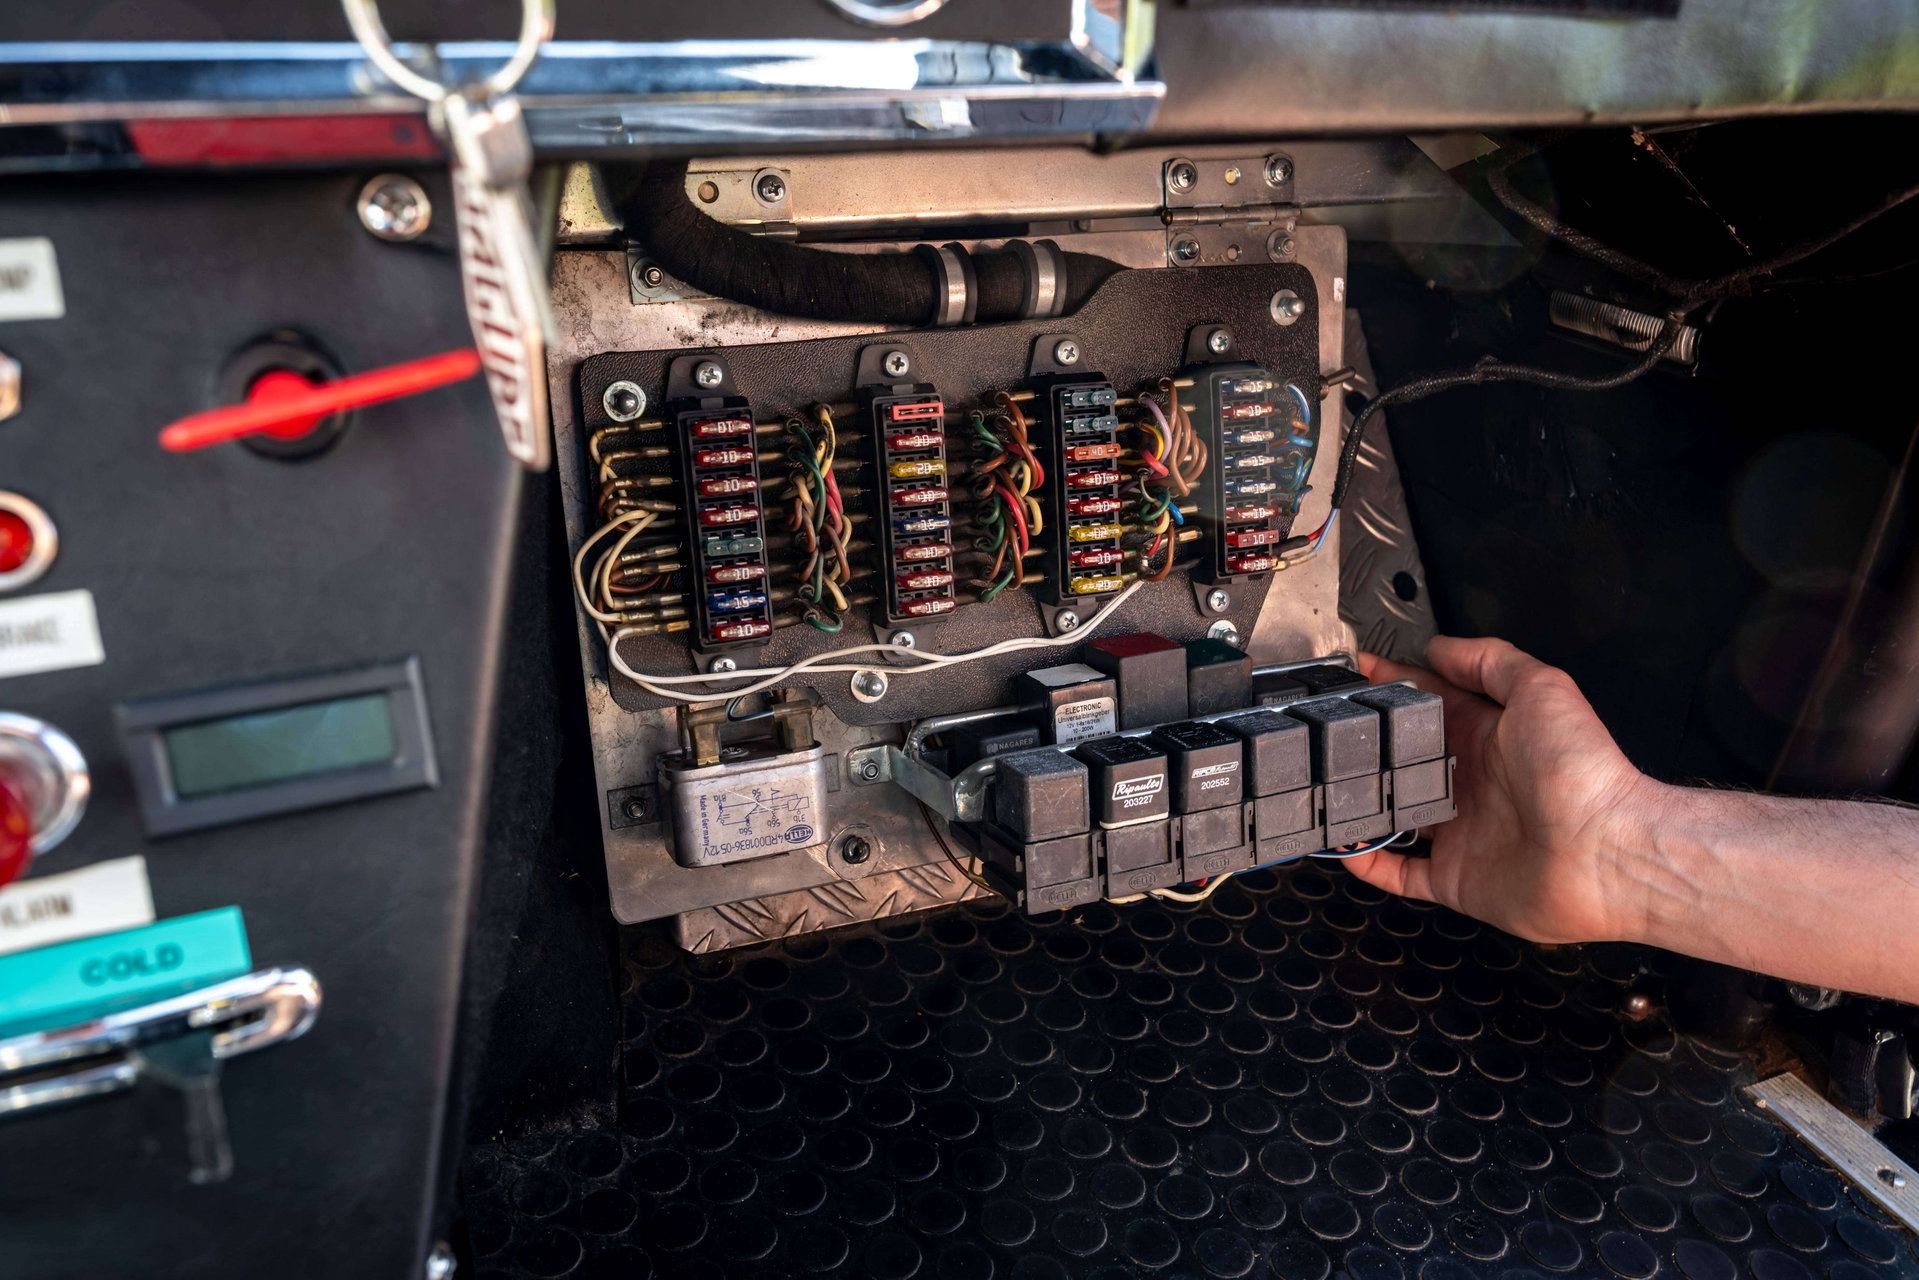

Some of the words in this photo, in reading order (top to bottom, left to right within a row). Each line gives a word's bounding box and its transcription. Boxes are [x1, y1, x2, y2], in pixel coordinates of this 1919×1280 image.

[722, 450, 737, 464] 10
[723, 479, 740, 493] 10
[725, 509, 741, 522] 10
[1253, 534, 1265, 544] 10
[735, 568, 750, 580] 10
[735, 598, 750, 609] 15
[738, 624, 753, 637] 10
[1065, 701, 1101, 715] ELECTRONIC
[998, 737, 1034, 750] NAGARES
[1116, 779, 1161, 796] Ripaults
[1201, 777, 1230, 790] 202552
[1124, 795, 1154, 808] 203227
[784, 829, 812, 841] HELLA
[80, 942, 185, 987] COLD
